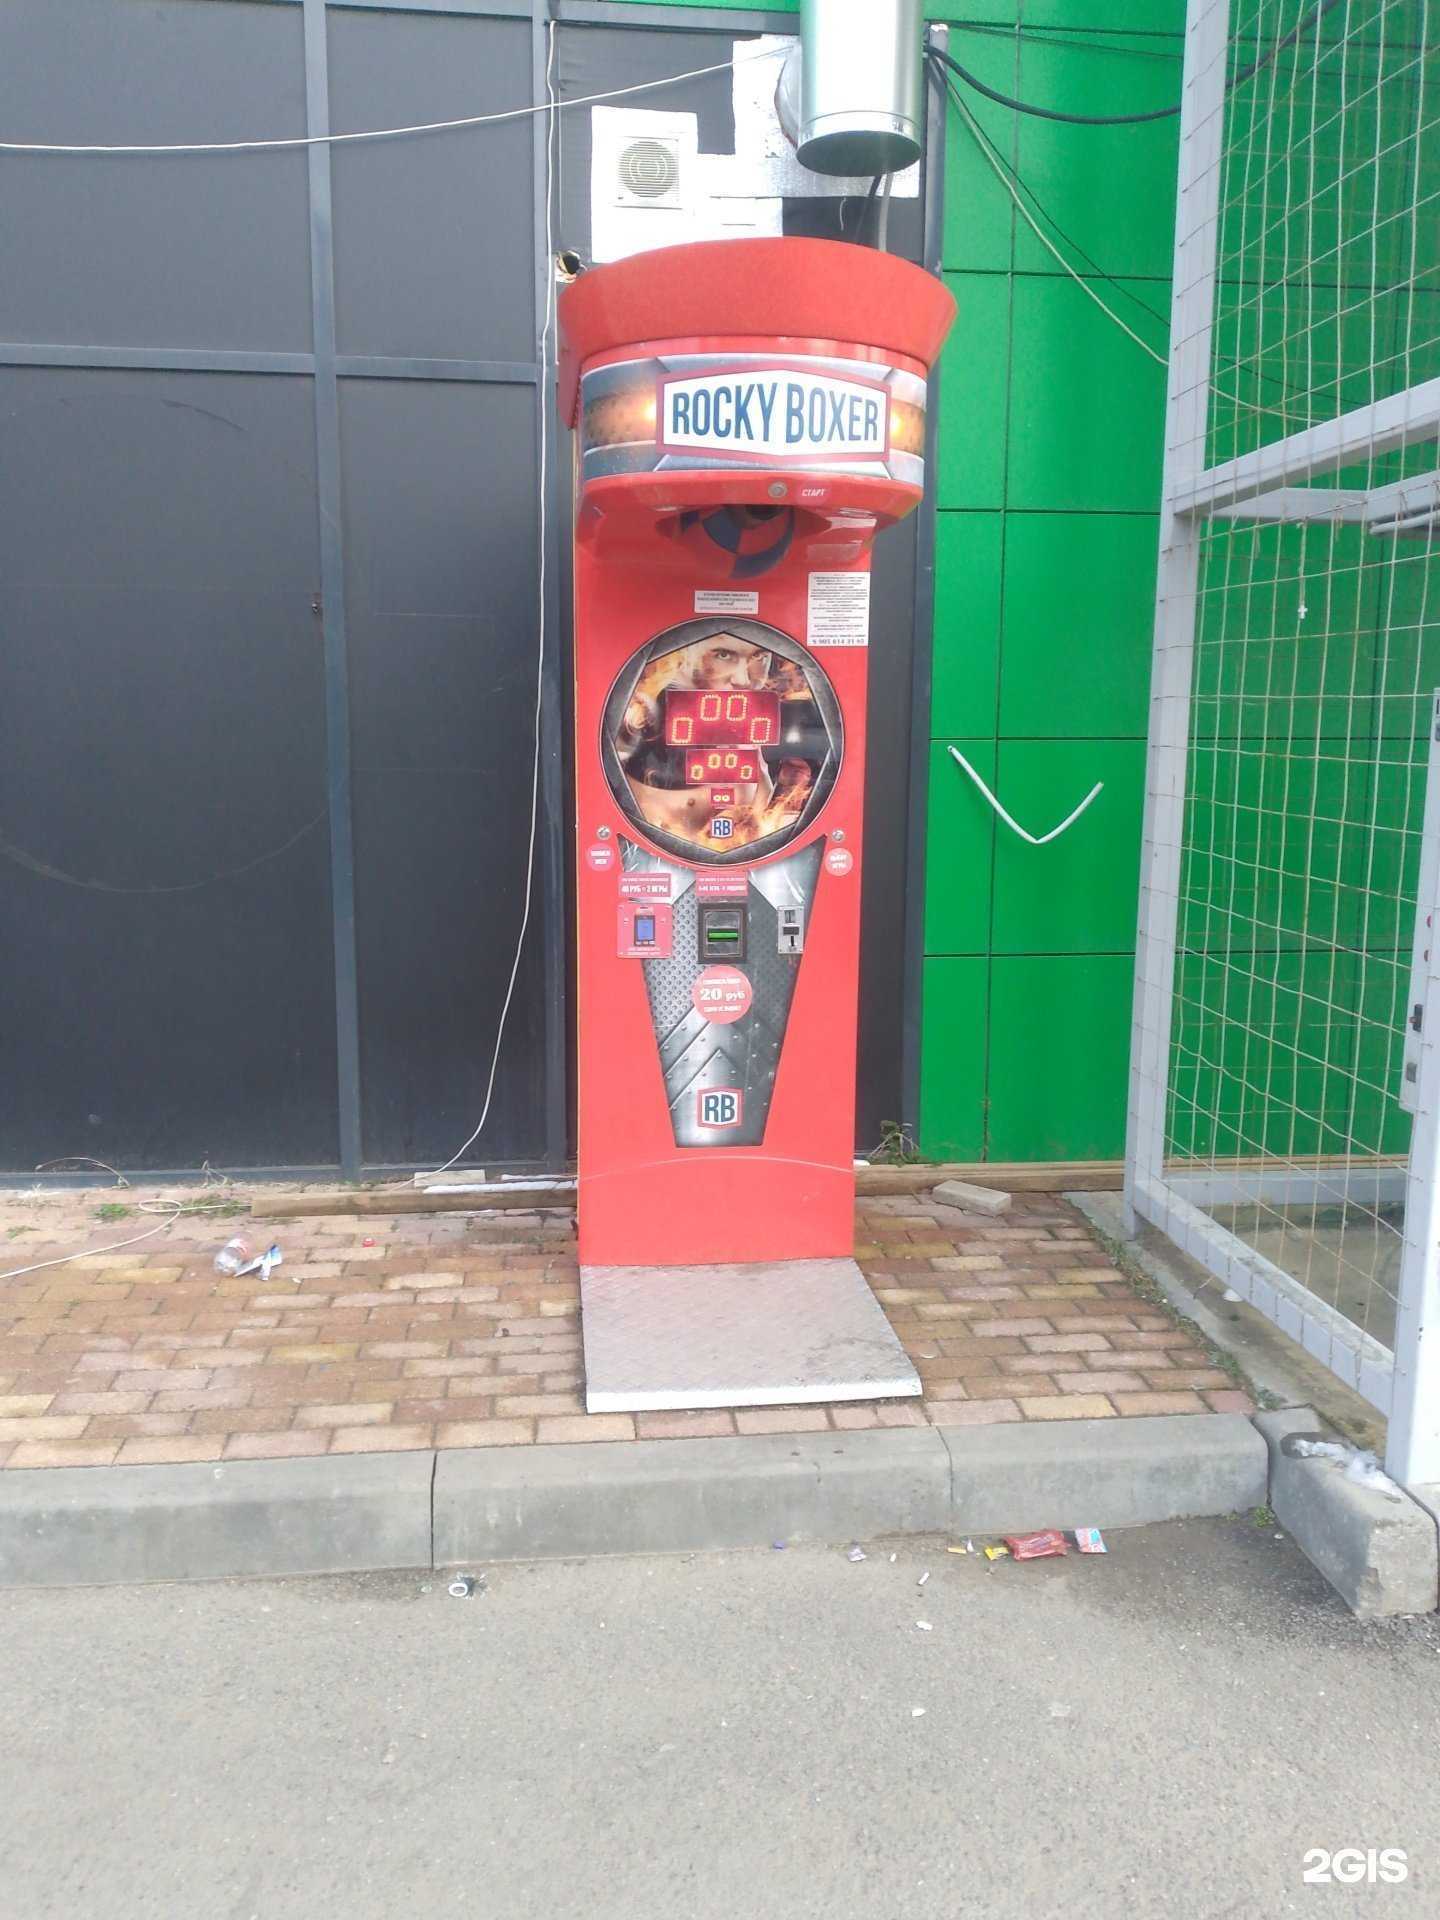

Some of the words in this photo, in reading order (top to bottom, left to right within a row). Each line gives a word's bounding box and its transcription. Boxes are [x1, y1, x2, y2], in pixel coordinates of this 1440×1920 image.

[672, 382, 778, 442] ROCKY
[785, 383, 879, 443] BOXER
[713, 819, 731, 836] RB
[700, 988, 722, 1001] 20
[725, 990, 745, 1002] руб
[704, 1094, 735, 1122] RB
